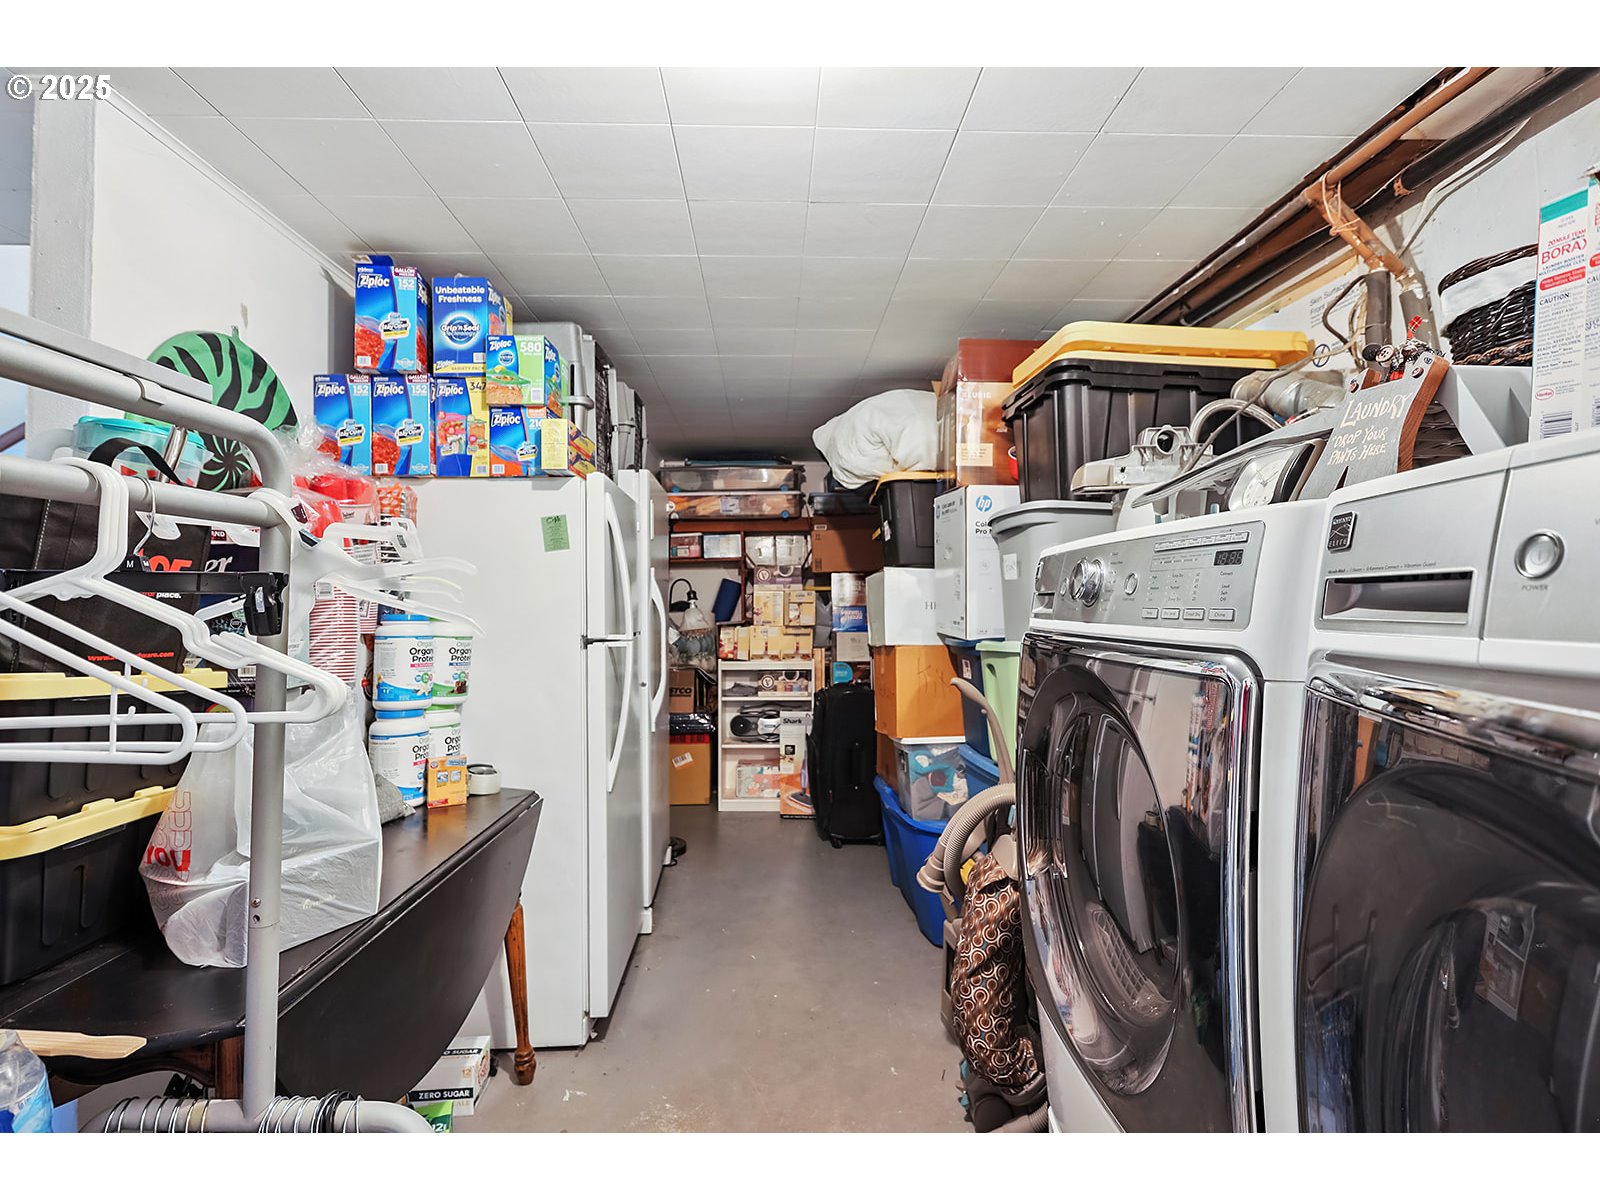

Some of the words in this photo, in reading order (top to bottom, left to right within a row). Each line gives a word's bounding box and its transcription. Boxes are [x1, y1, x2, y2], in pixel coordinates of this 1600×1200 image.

[360, 274, 390, 289] Ziploc
[398, 278, 415, 289] 152
[435, 286, 486, 295] Unbeatable
[437, 294, 483, 303] Freshness
[489, 340, 512, 351] Ziploc
[519, 341, 542, 353] 580
[318, 384, 345, 397] Ziploc
[352, 384, 369, 395] 152
[376, 384, 404, 397] Ziploc
[411, 384, 427, 395] 152
[439, 384, 464, 398] Ziploc
[468, 381, 487, 391] 347
[1340, 393, 1414, 429] LAUNDRY
[493, 414, 521, 427] Ziploc
[1363, 426, 1389, 444] YOUR
[1327, 446, 1358, 466] PANTS
[126, 560, 134, 568] M
[1521, 583, 1549, 592] POWER
[418, 1091, 442, 1100] ZERO
[442, 1089, 471, 1098] SUGAR
